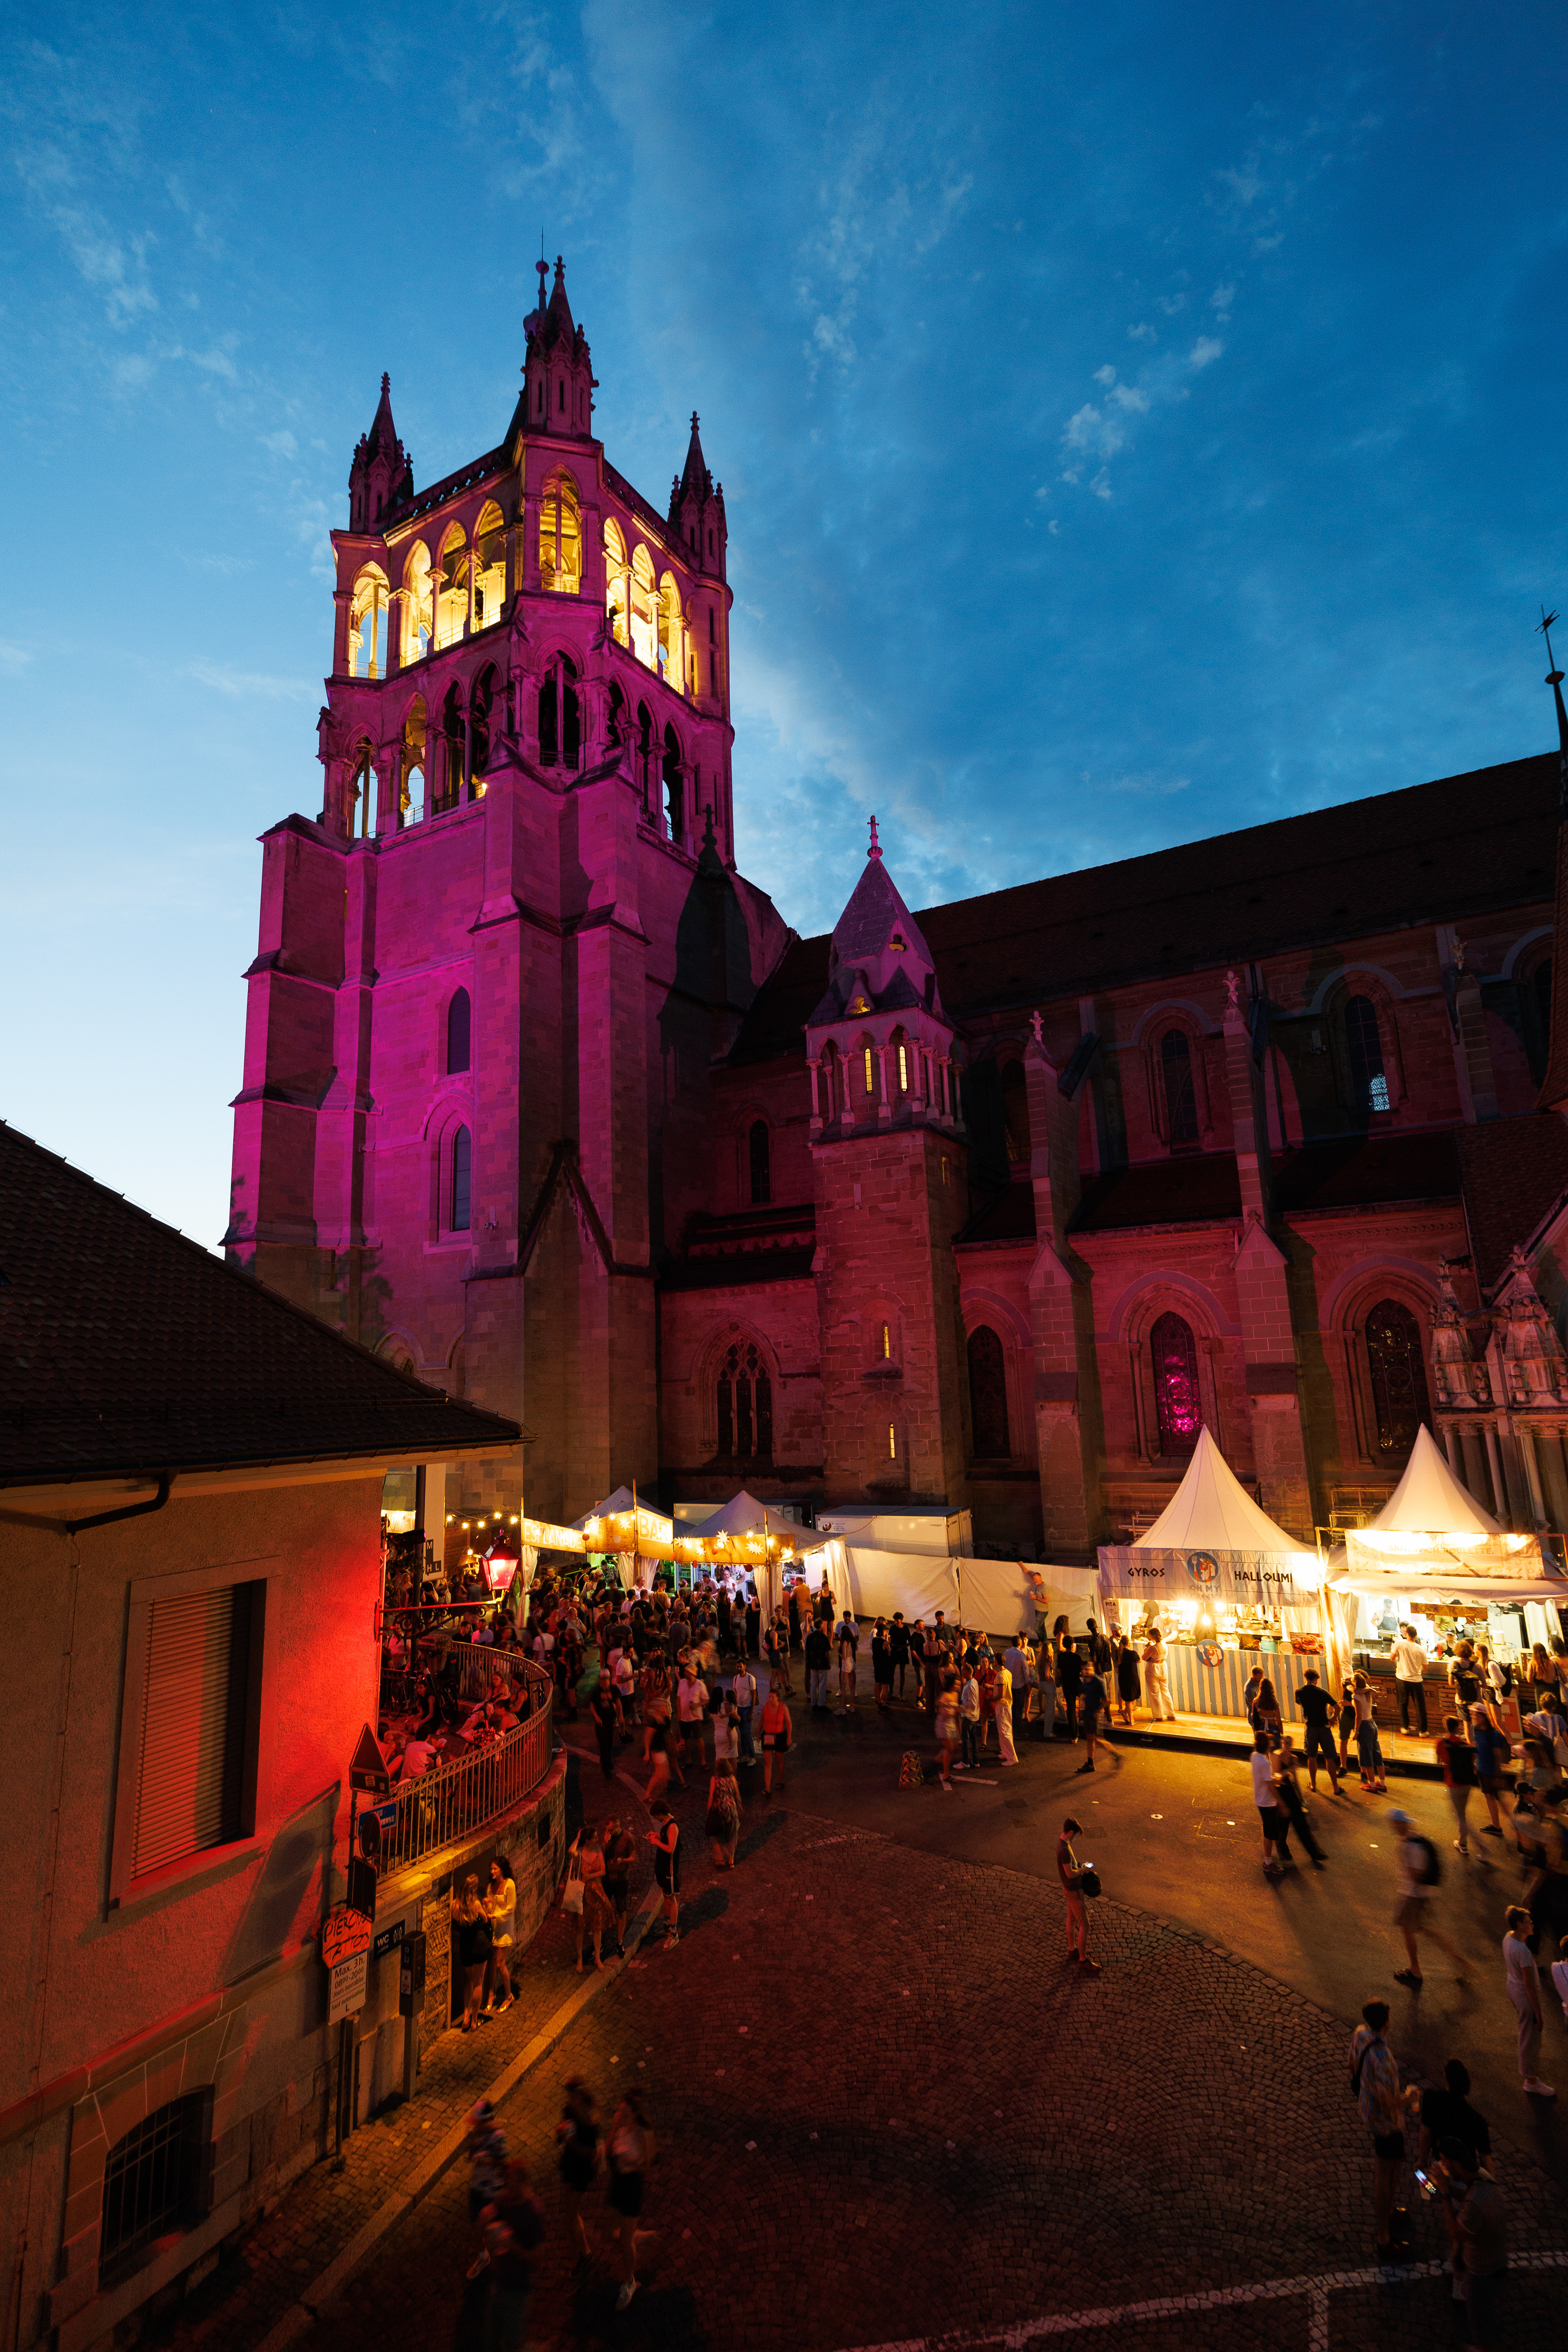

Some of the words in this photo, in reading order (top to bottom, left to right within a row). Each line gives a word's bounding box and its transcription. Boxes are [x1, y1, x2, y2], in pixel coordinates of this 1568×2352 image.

[639, 1515, 668, 1541] BAR
[524, 1522, 583, 1550] ESPLANADE
[427, 1541, 432, 1550] M
[427, 1564, 432, 1572] H
[435, 1563, 439, 1571] L
[1127, 1568, 1165, 1577] GYROS
[1234, 1570, 1293, 1583] HALLOUMI
[377, 1934, 389, 1948] WC
[335, 1964, 352, 1980] Max.
[333, 1988, 344, 1998] Jours
[345, 1976, 364, 1991] ouvrables
[332, 2000, 341, 2011] Sauf
[341, 1988, 364, 2005] autorisation
